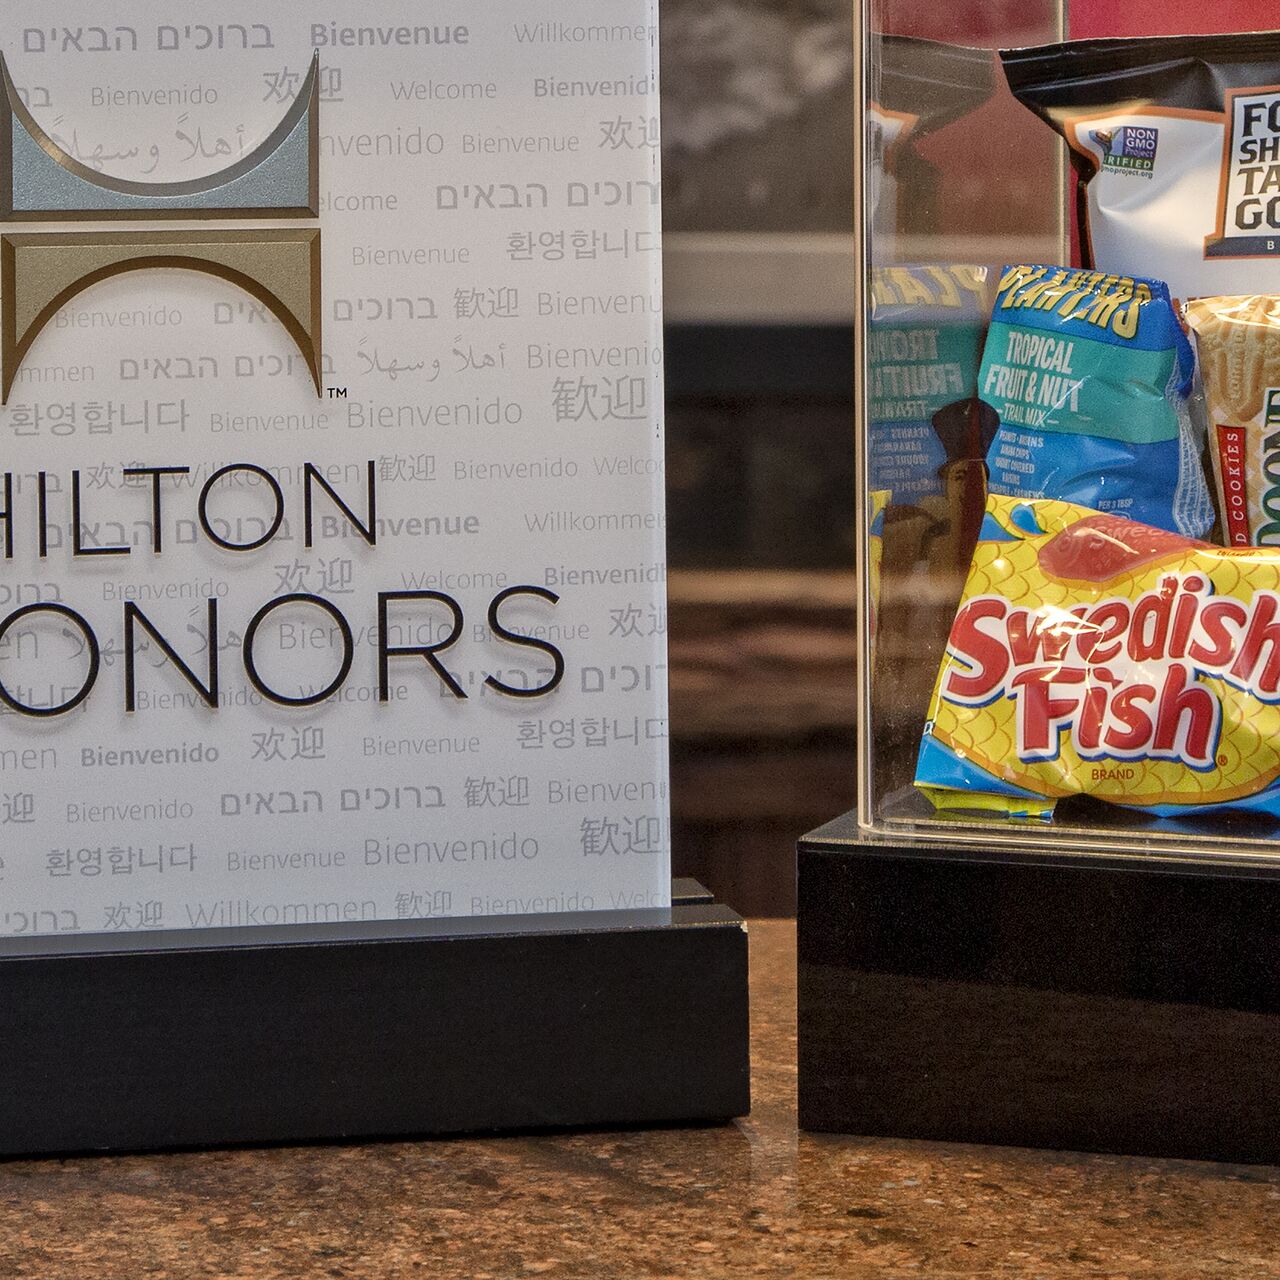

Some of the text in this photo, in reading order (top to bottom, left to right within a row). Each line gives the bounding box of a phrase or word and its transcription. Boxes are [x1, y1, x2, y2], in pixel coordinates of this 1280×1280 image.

[310, 21, 470, 48] Bienvenue
[91, 84, 218, 107] Bienvenido
[389, 79, 498, 102] Welcome
[461, 133, 580, 155] Bienvenue
[1126, 127, 1156, 140] NON
[1126, 138, 1155, 150] GMO
[1007, 331, 1075, 374] TROPICAL
[983, 363, 1084, 413] FRUIT & NUT
[8, 399, 190, 438] 환영합니다
[346, 396, 523, 429] Bienvenido
[1003, 402, 1048, 428] TRAIL MIX
[453, 457, 579, 481] Bienvenido
[1226, 431, 1247, 521] COOKIES
[272, 557, 355, 596] 欢迎
[1008, 661, 1213, 766] Fish
[80, 741, 220, 768] Bienvenido
[250, 725, 327, 762] 欢迎
[362, 734, 481, 756] Bienvenue
[1091, 768, 1135, 783] BRAND
[65, 798, 194, 824] Bienvenido
[45, 843, 198, 879] 환영합니다
[363, 832, 541, 866] Bienvenido
